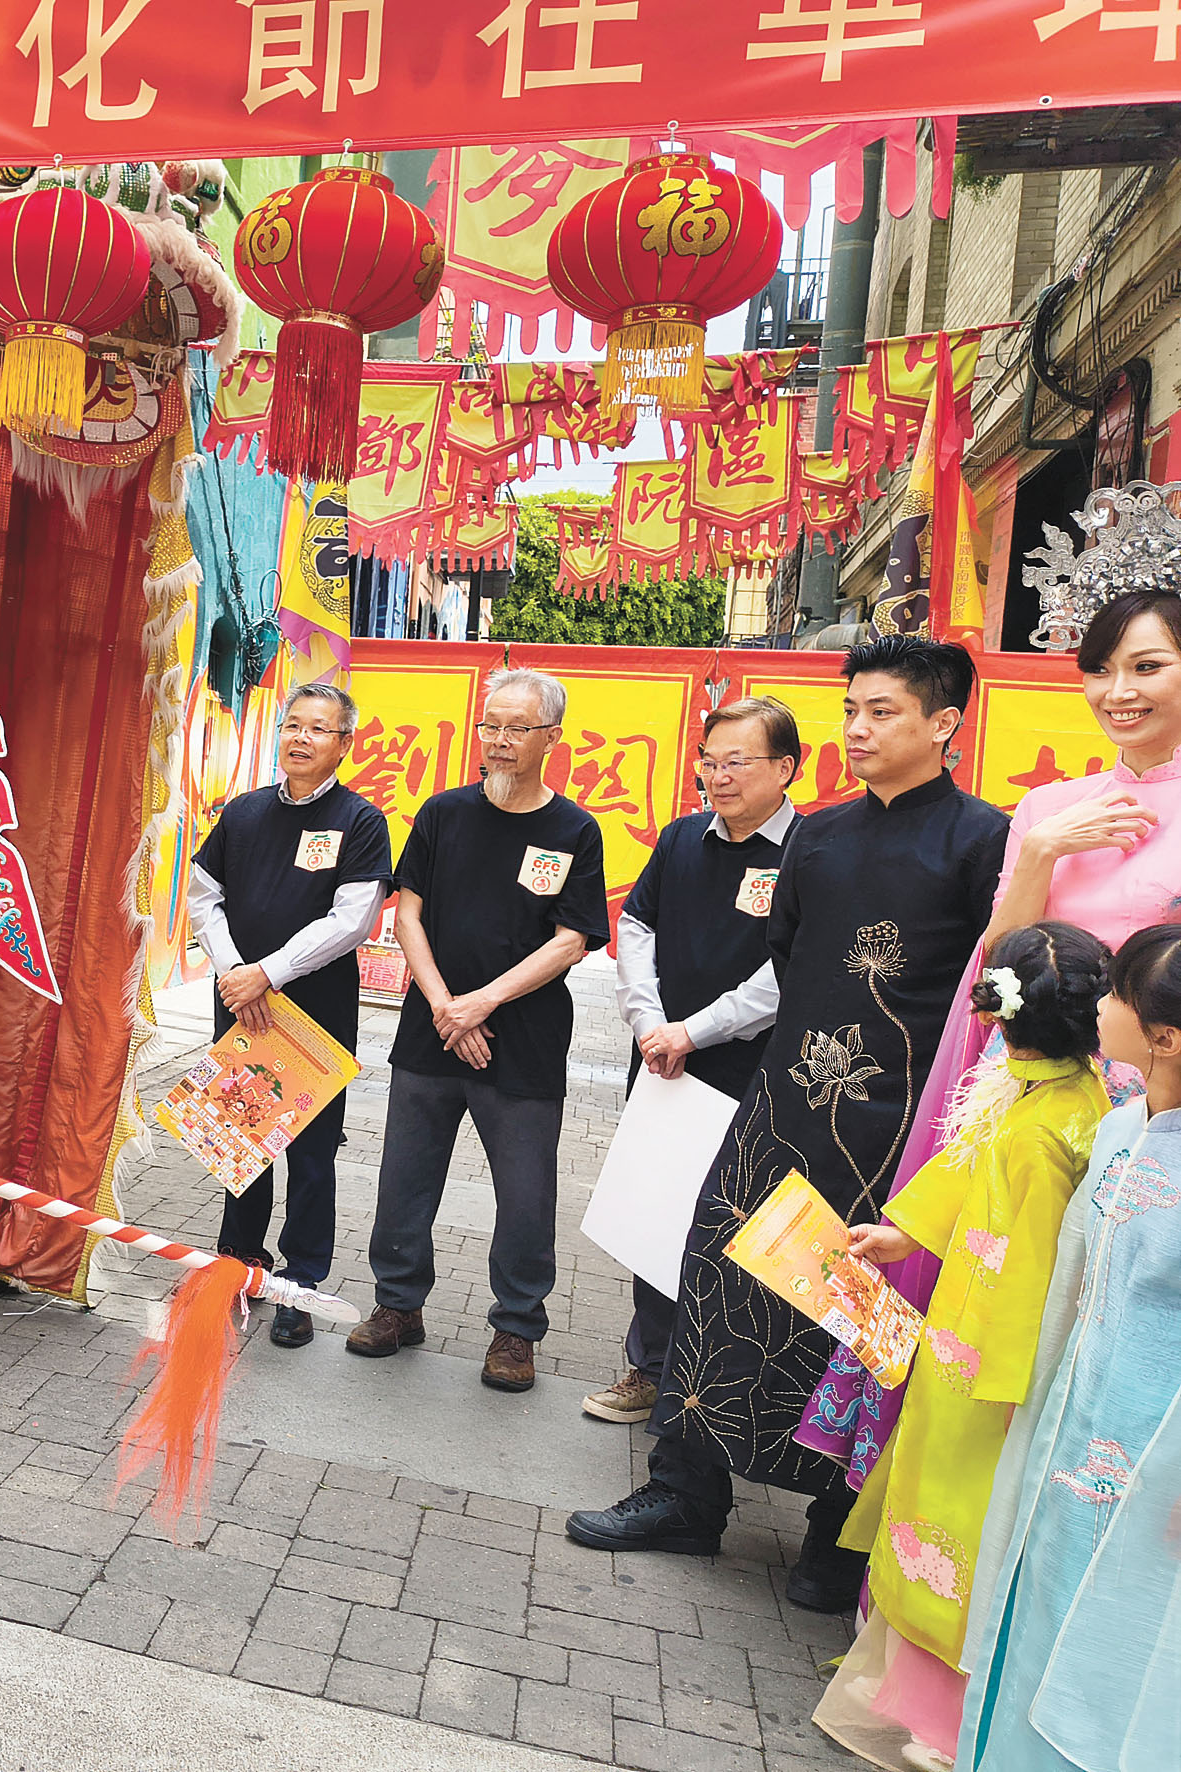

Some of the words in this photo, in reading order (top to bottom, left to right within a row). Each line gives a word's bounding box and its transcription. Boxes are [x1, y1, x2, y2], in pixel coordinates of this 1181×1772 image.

[239, 197, 293, 267] 福
[636, 179, 731, 258] 福
[348, 715, 456, 827] 劉
[307, 840, 332, 849] CFC
[533, 859, 561, 872] CFC
